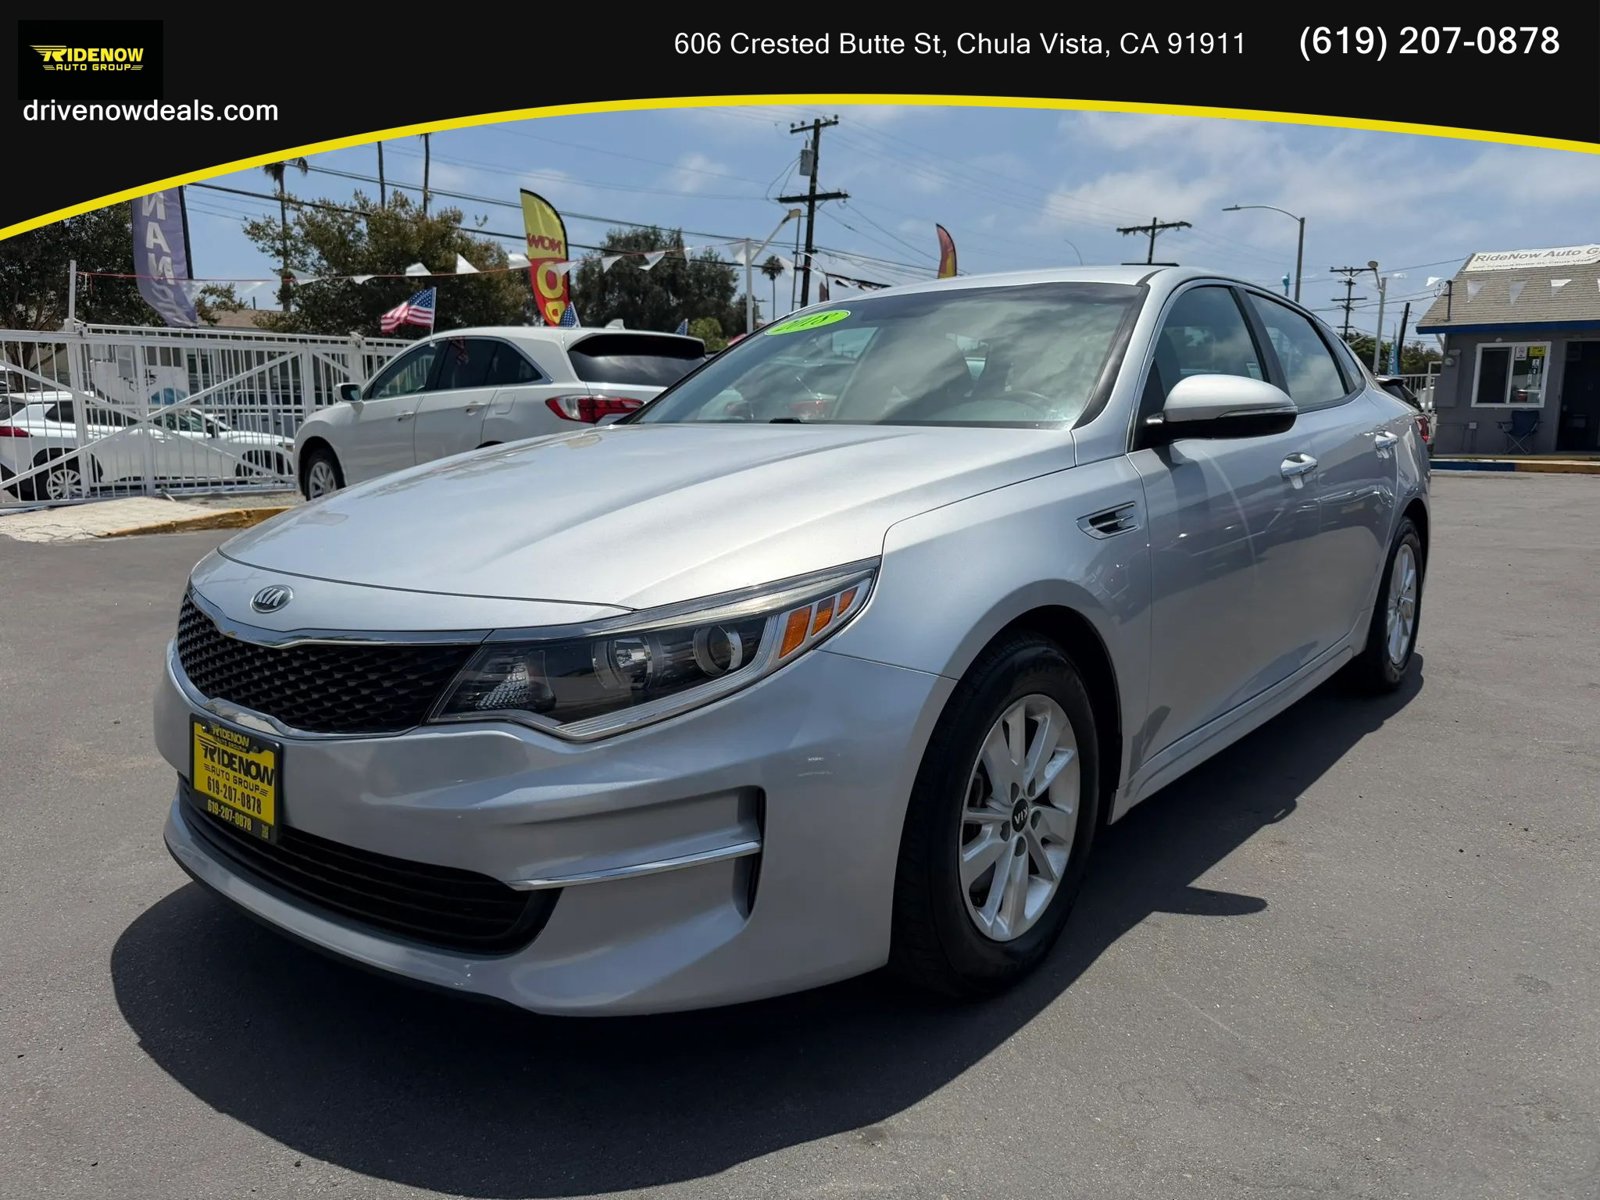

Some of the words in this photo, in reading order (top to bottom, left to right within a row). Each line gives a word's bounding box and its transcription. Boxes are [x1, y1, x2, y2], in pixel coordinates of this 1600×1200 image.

[1474, 251, 1541, 262] RideNow
[1543, 248, 1581, 258] Auto
[254, 587, 285, 607] KIA
[200, 738, 275, 787] RIDENOW
[211, 766, 231, 782] AUTO
[233, 775, 260, 793] GROUP
[207, 775, 262, 815] 619-207-0878
